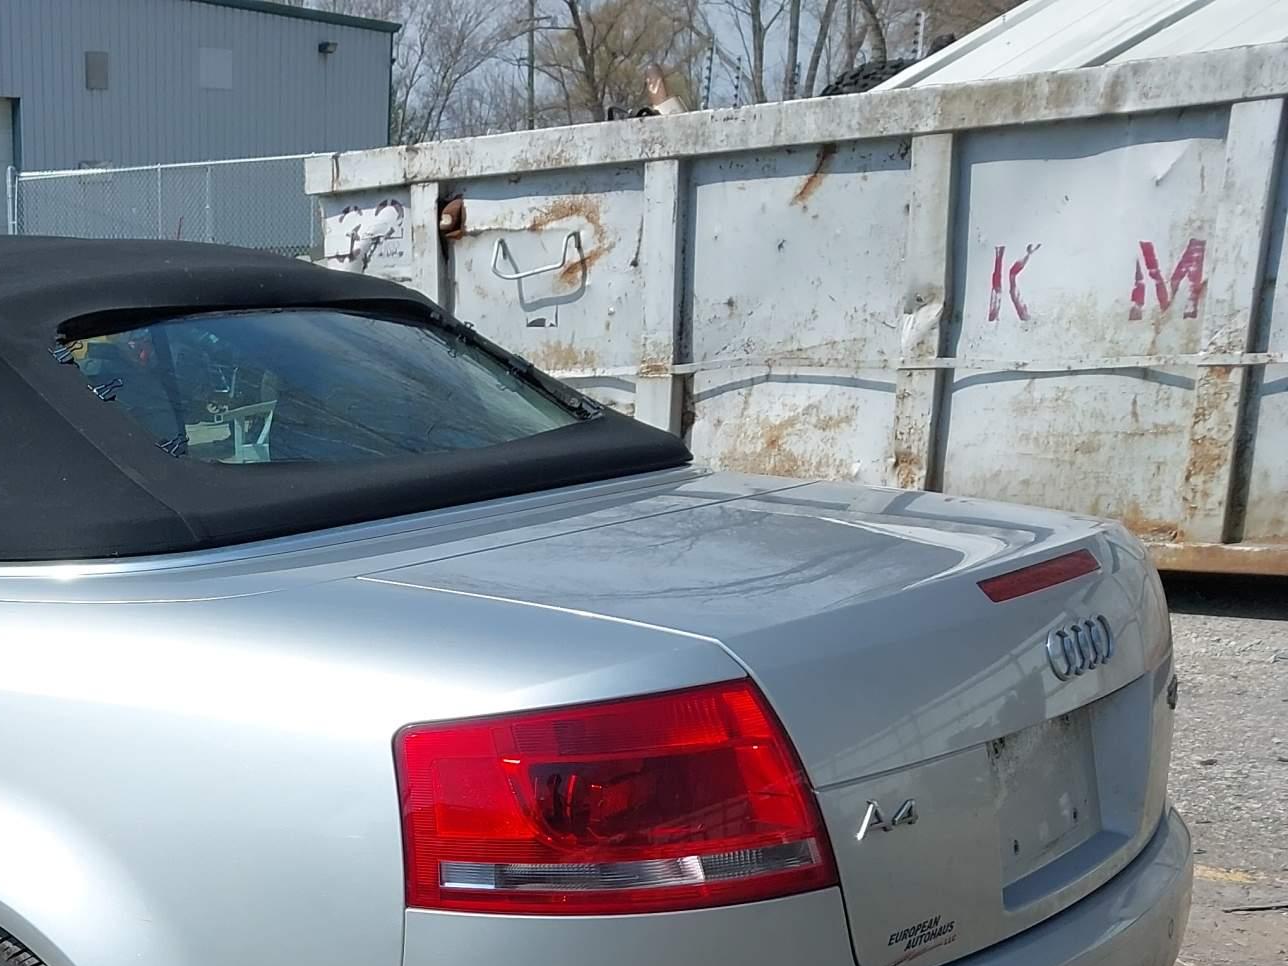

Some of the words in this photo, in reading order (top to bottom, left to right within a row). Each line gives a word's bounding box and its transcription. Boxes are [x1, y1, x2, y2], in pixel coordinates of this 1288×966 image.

[988, 243, 1042, 321] K
[1128, 238, 1207, 321] M
[856, 799, 919, 841] A4
[887, 915, 941, 946] EUROPEAN
[903, 920, 955, 951] AUTOHAUS
